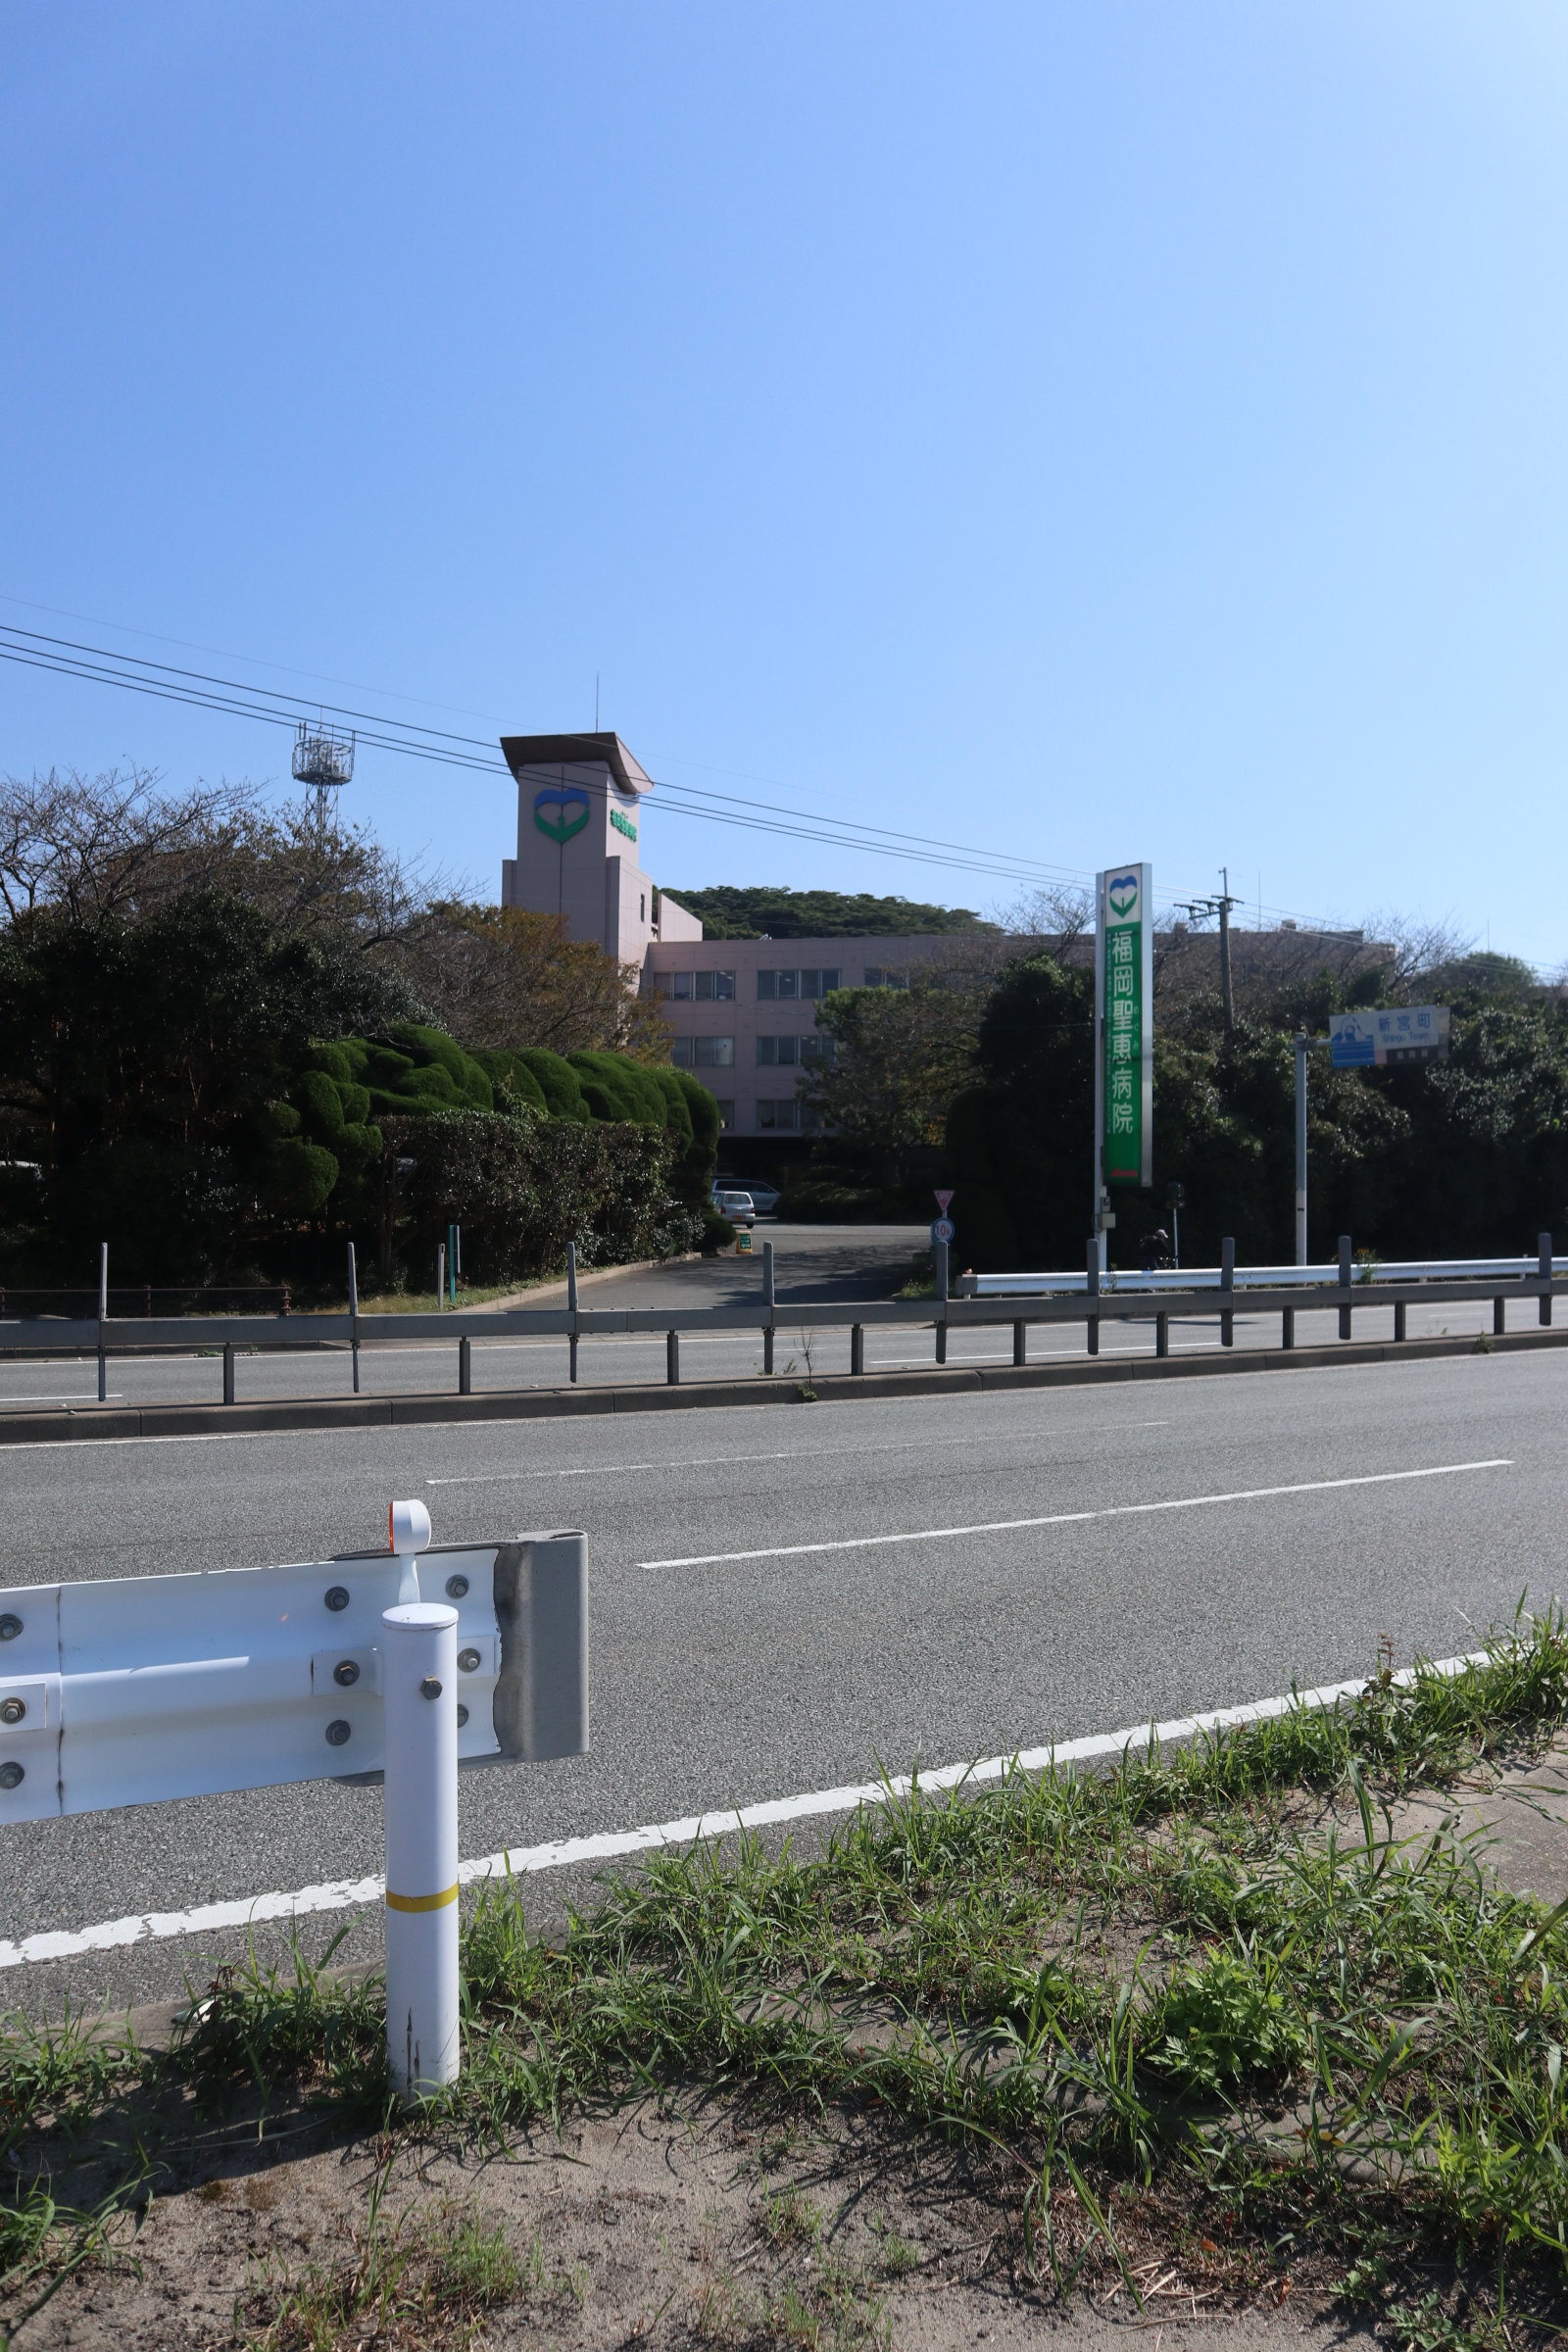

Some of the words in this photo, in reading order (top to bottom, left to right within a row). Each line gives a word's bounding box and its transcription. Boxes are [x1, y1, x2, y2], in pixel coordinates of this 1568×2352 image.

[1111, 930, 1134, 1135] 福岡聖恵病院
[1378, 1012, 1431, 1033] 新宮町
[1382, 1034, 1406, 1044] Shingu
[1407, 1031, 1430, 1041] Town
